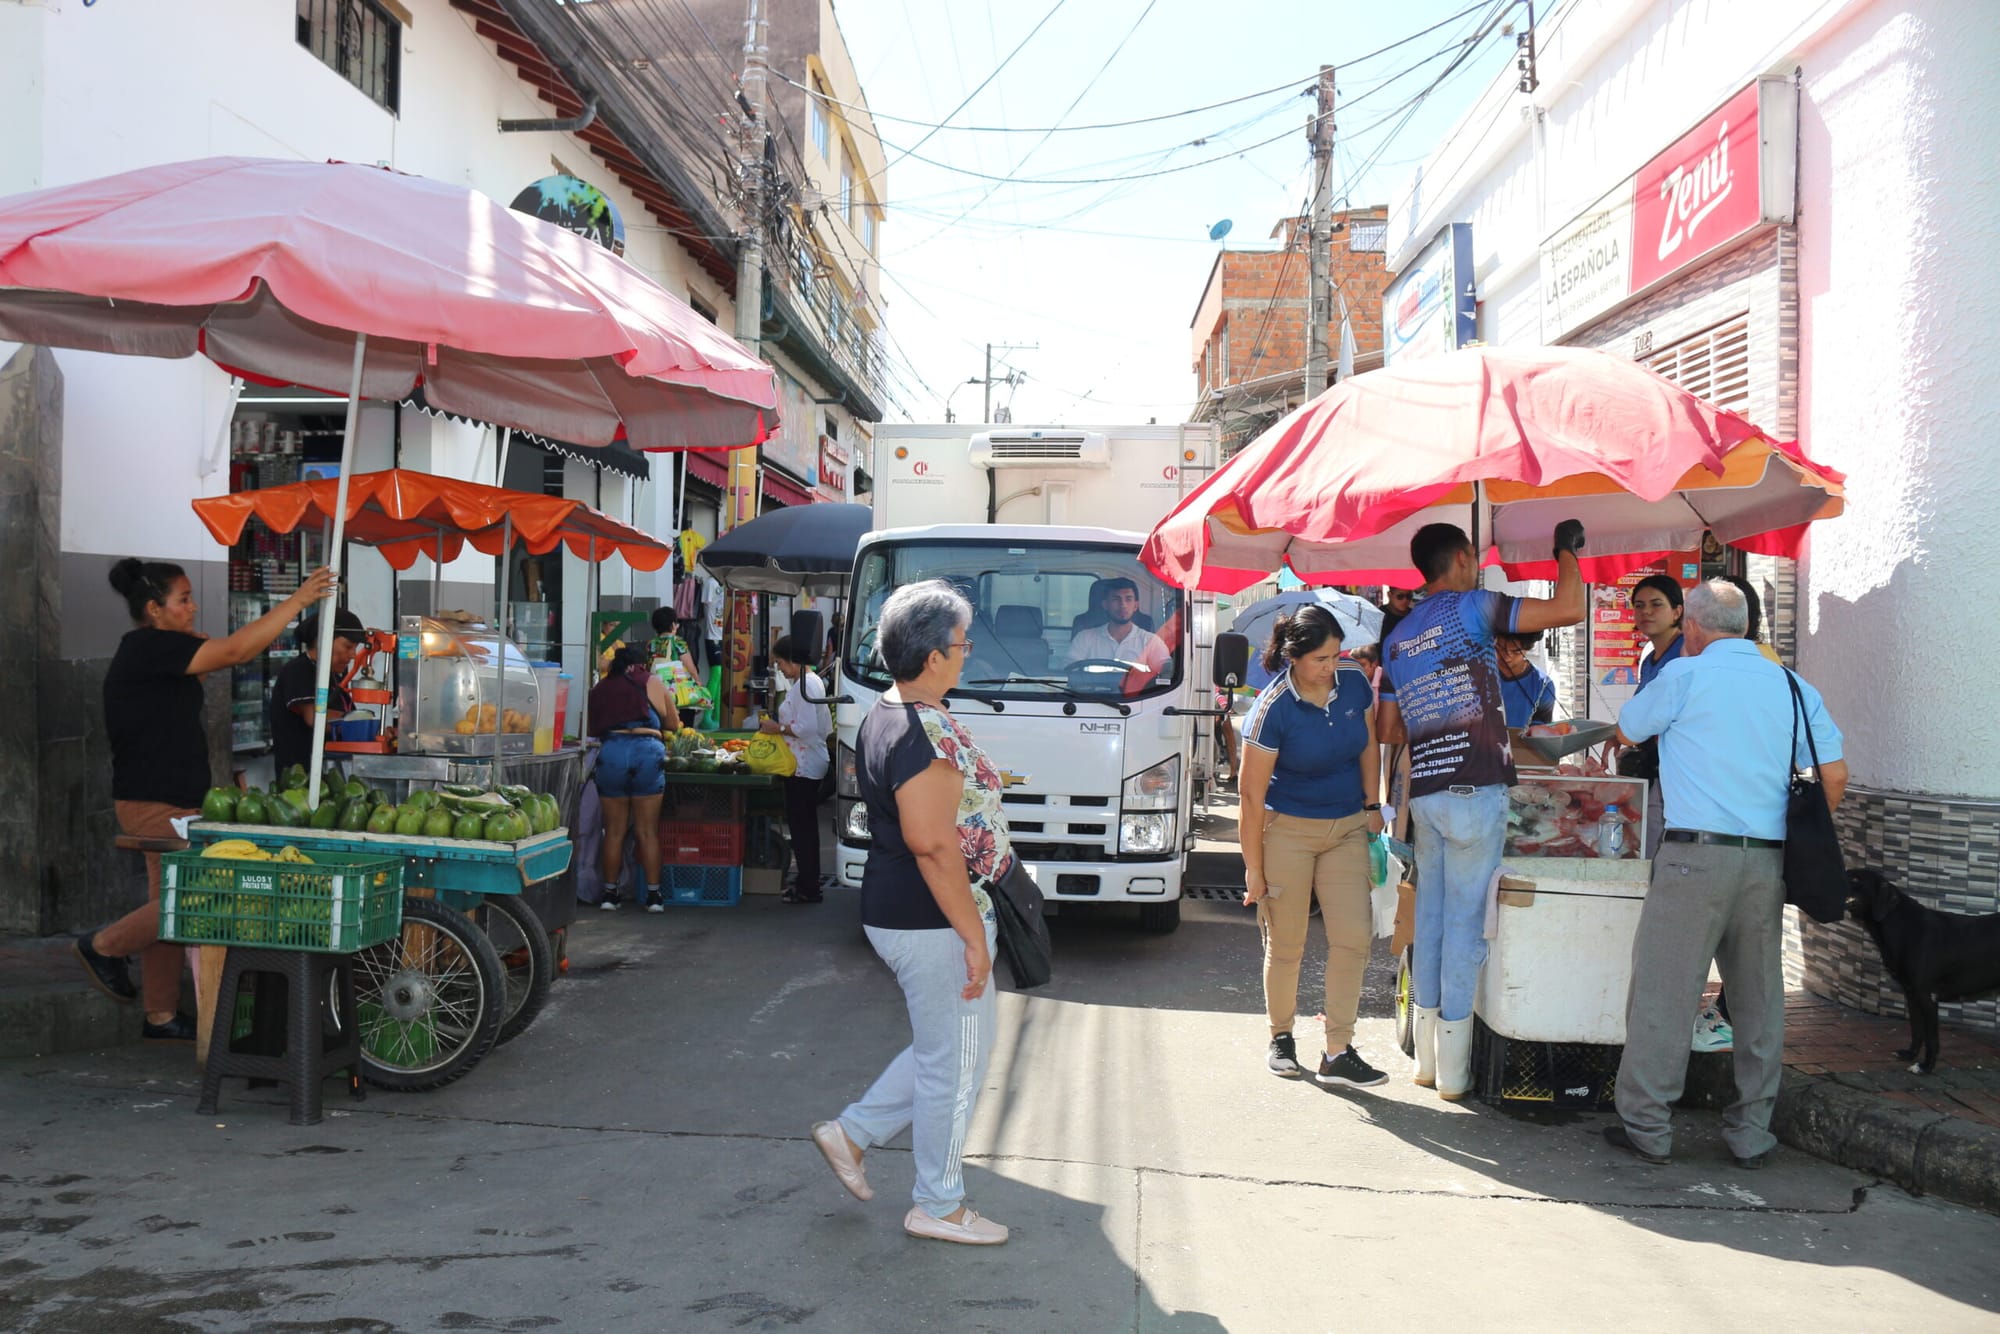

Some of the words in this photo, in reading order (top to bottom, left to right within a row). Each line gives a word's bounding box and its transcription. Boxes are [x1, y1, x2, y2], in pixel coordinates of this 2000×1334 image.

[1658, 120, 1729, 261] Zenú
[1546, 279, 1560, 305] LA
[1560, 238, 1620, 296] ESPAÑOLA
[1408, 639, 1437, 657] CLAUDIA
[1440, 663, 1470, 677] CACHAMA
[242, 875, 267, 883] LULOS
